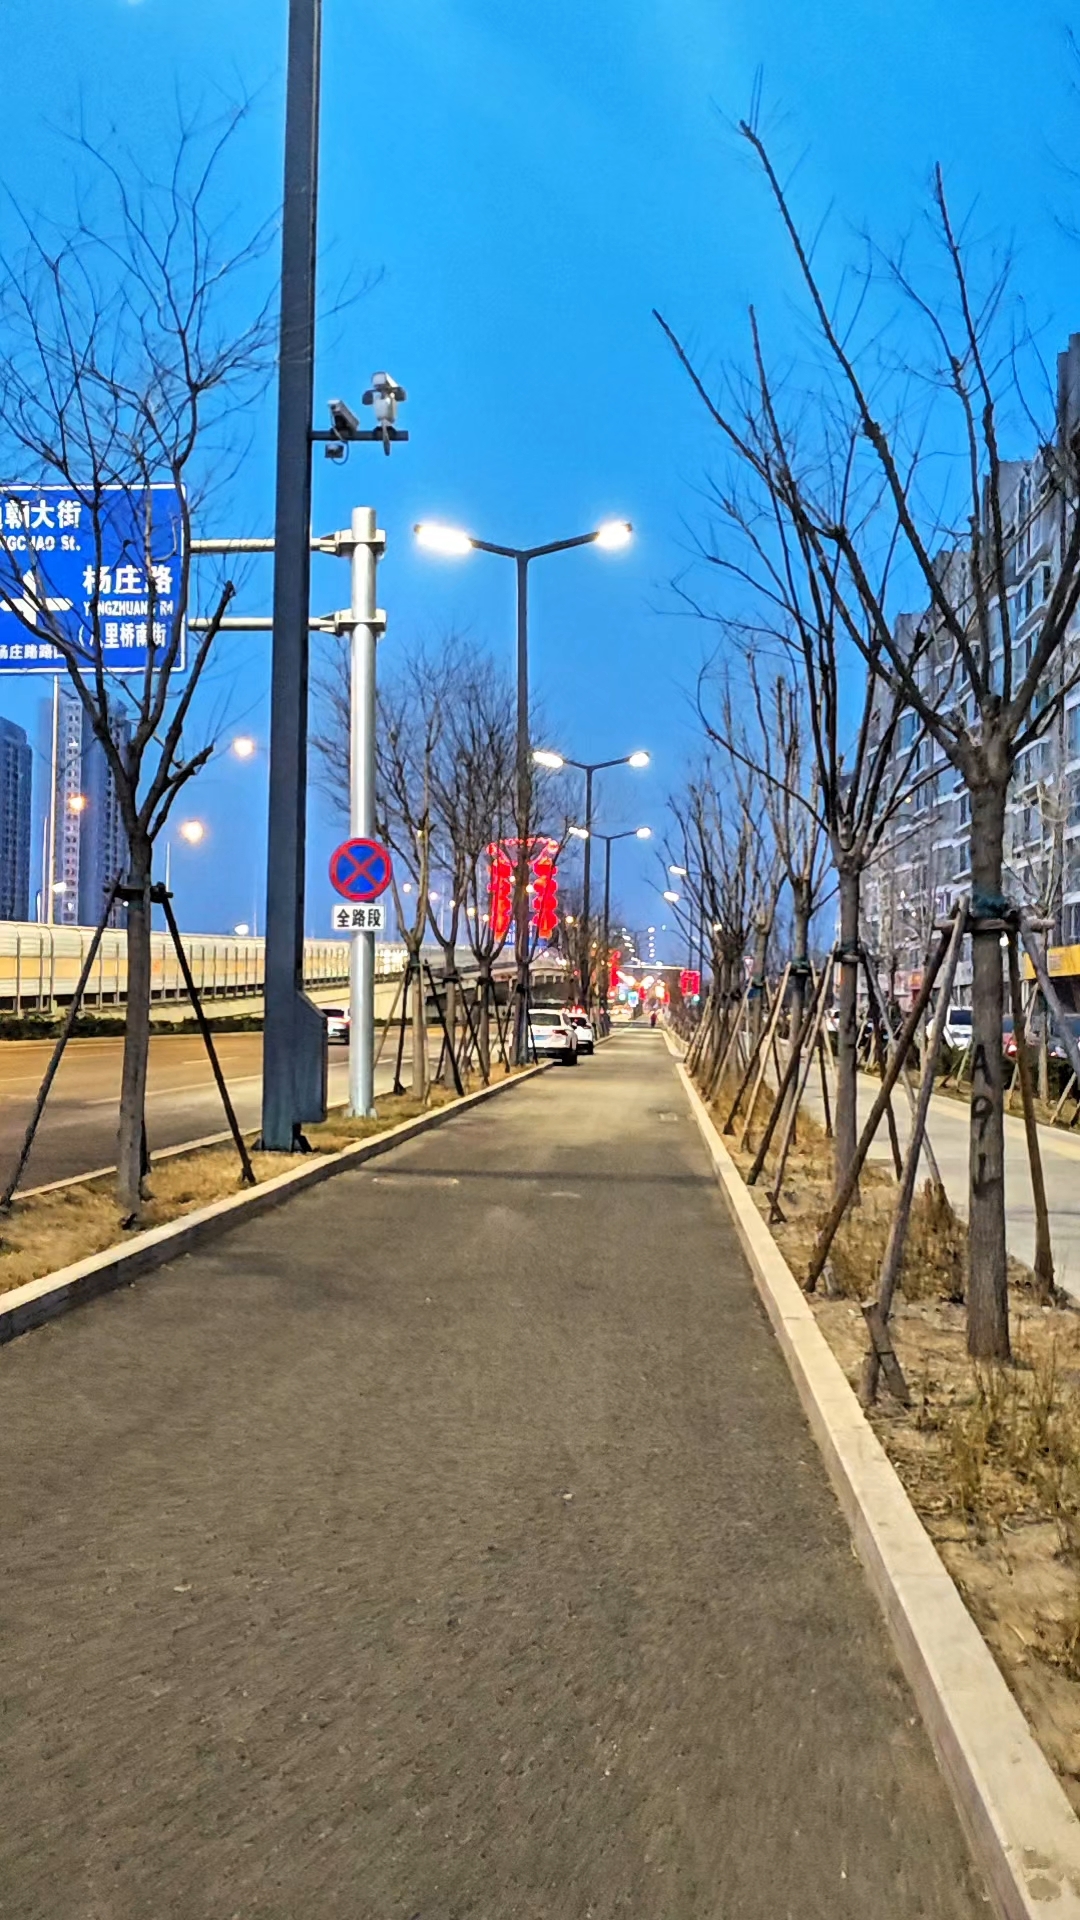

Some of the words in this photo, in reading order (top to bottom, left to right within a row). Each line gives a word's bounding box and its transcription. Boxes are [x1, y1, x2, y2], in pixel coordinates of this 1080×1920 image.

[0, 499, 81, 529] 朝大街
[82, 564, 172, 594] 杨庄路
[337, 908, 381, 927] 全路段
